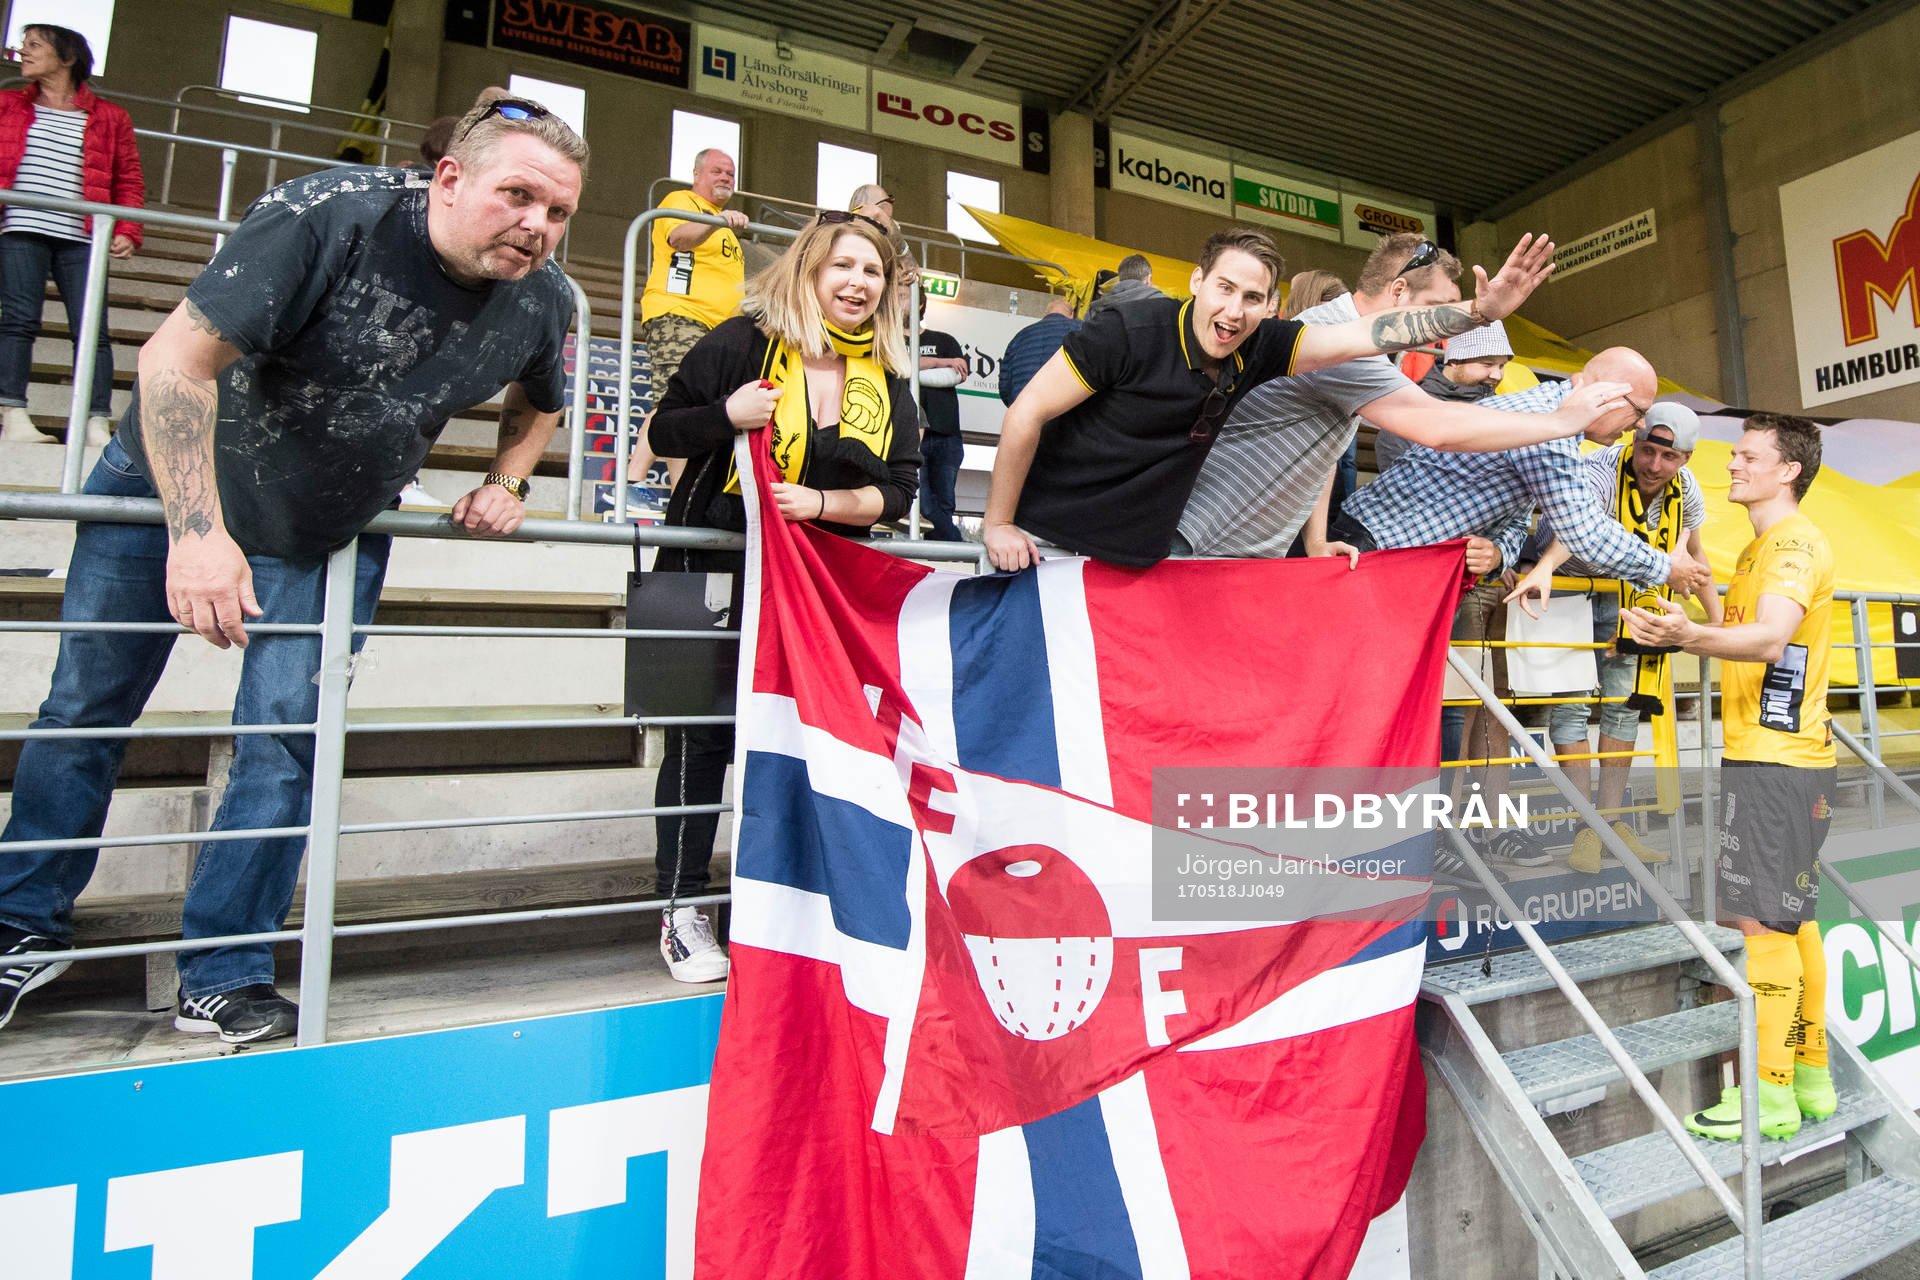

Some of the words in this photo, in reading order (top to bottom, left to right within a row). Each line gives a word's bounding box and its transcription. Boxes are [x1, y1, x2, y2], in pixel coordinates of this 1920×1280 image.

[503, 0, 674, 58] SWESAB
[741, 70, 808, 101] Älvsborg
[743, 55, 862, 95] Länsförsäkringar
[1118, 148, 1226, 200] kabona
[1258, 187, 1318, 219] SKYDDA
[1362, 208, 1418, 233] GROLLS
[1552, 236, 1600, 262] FÖRBJUDET
[1601, 229, 1616, 244] ATT
[1619, 220, 1634, 236] STÅ
[1637, 214, 1649, 229] PÅ
[1613, 228, 1653, 251] OMRÅDE
[1138, 946, 1188, 1048] F
